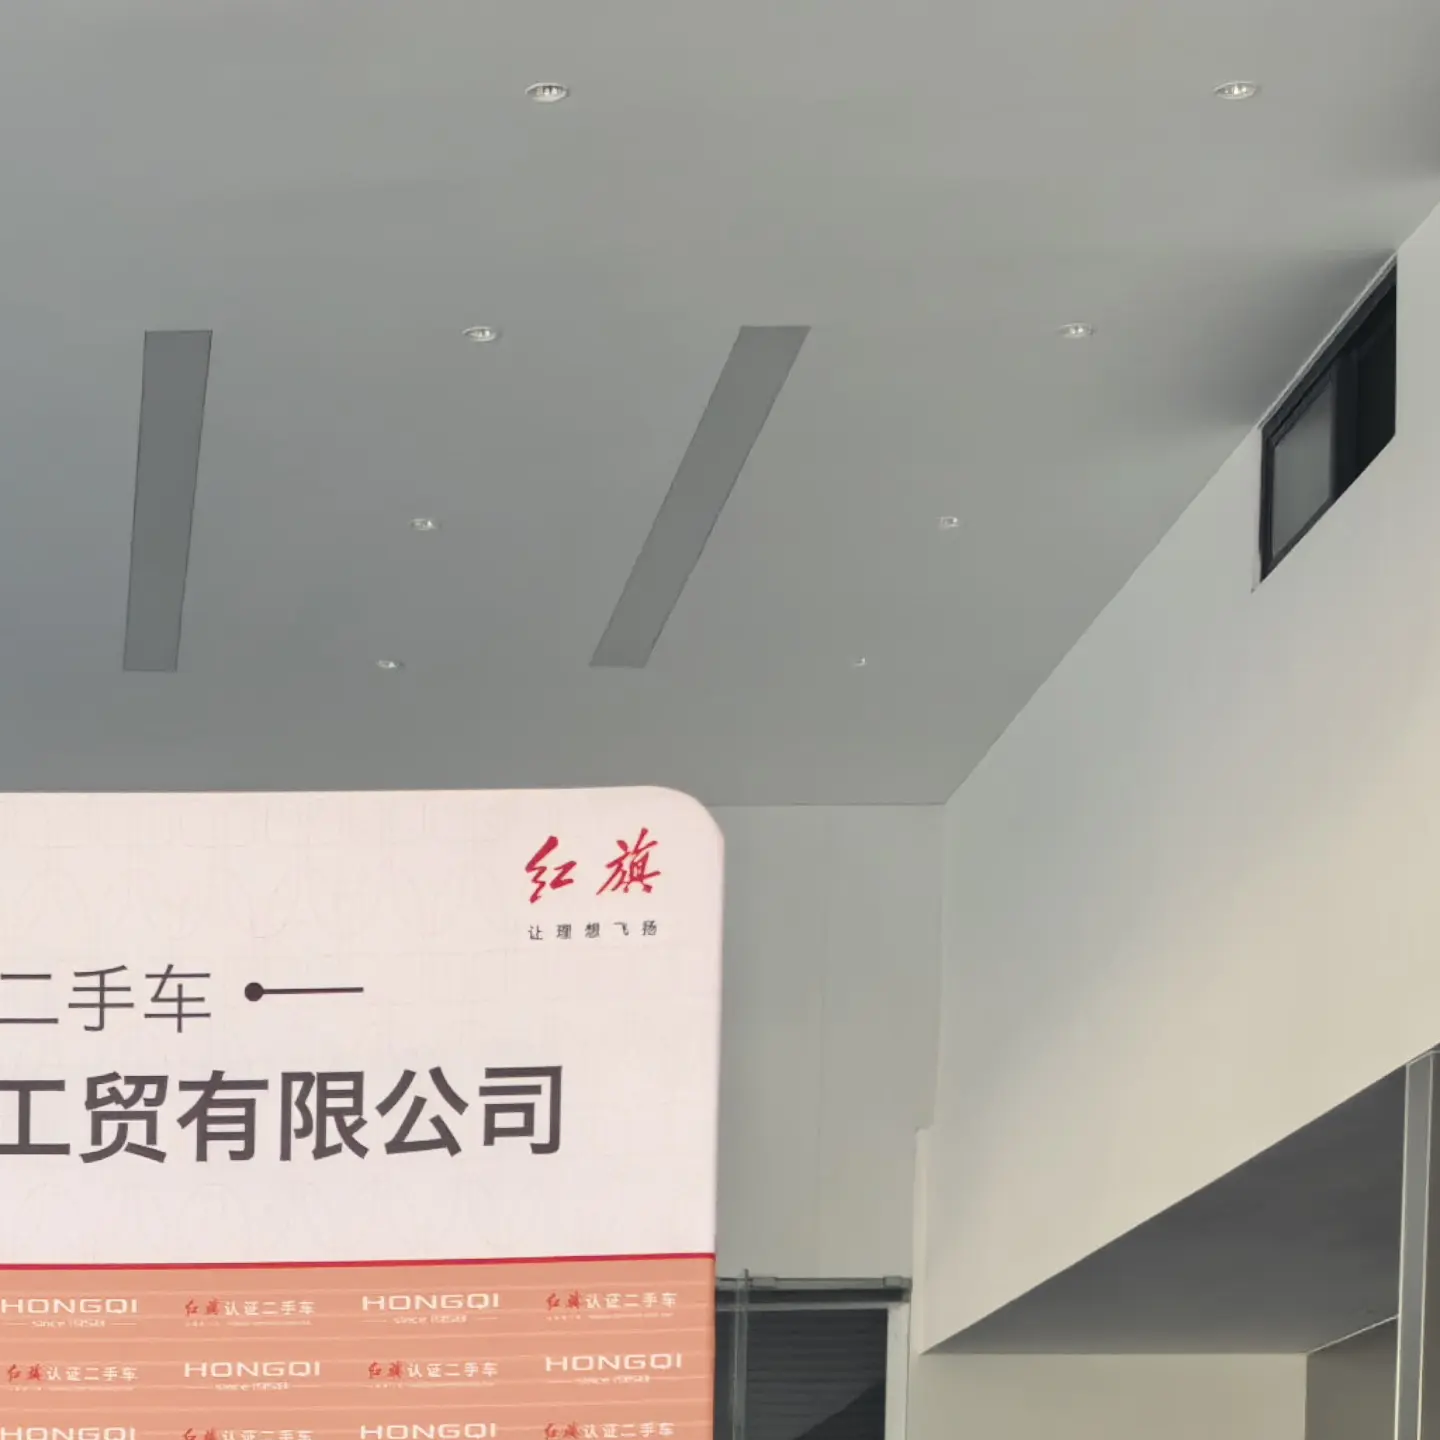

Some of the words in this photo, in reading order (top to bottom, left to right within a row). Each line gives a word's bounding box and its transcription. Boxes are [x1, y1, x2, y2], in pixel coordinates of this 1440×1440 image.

[525, 828, 660, 903] 红旗
[528, 920, 657, 941] 让理想飞扬
[0, 1298, 138, 1315] HONGQI
[362, 1293, 499, 1311] HONGQI
[184, 1360, 321, 1378] HONGQI
[545, 1352, 683, 1372] HONGQI
[360, 1422, 497, 1440] HONGQI
